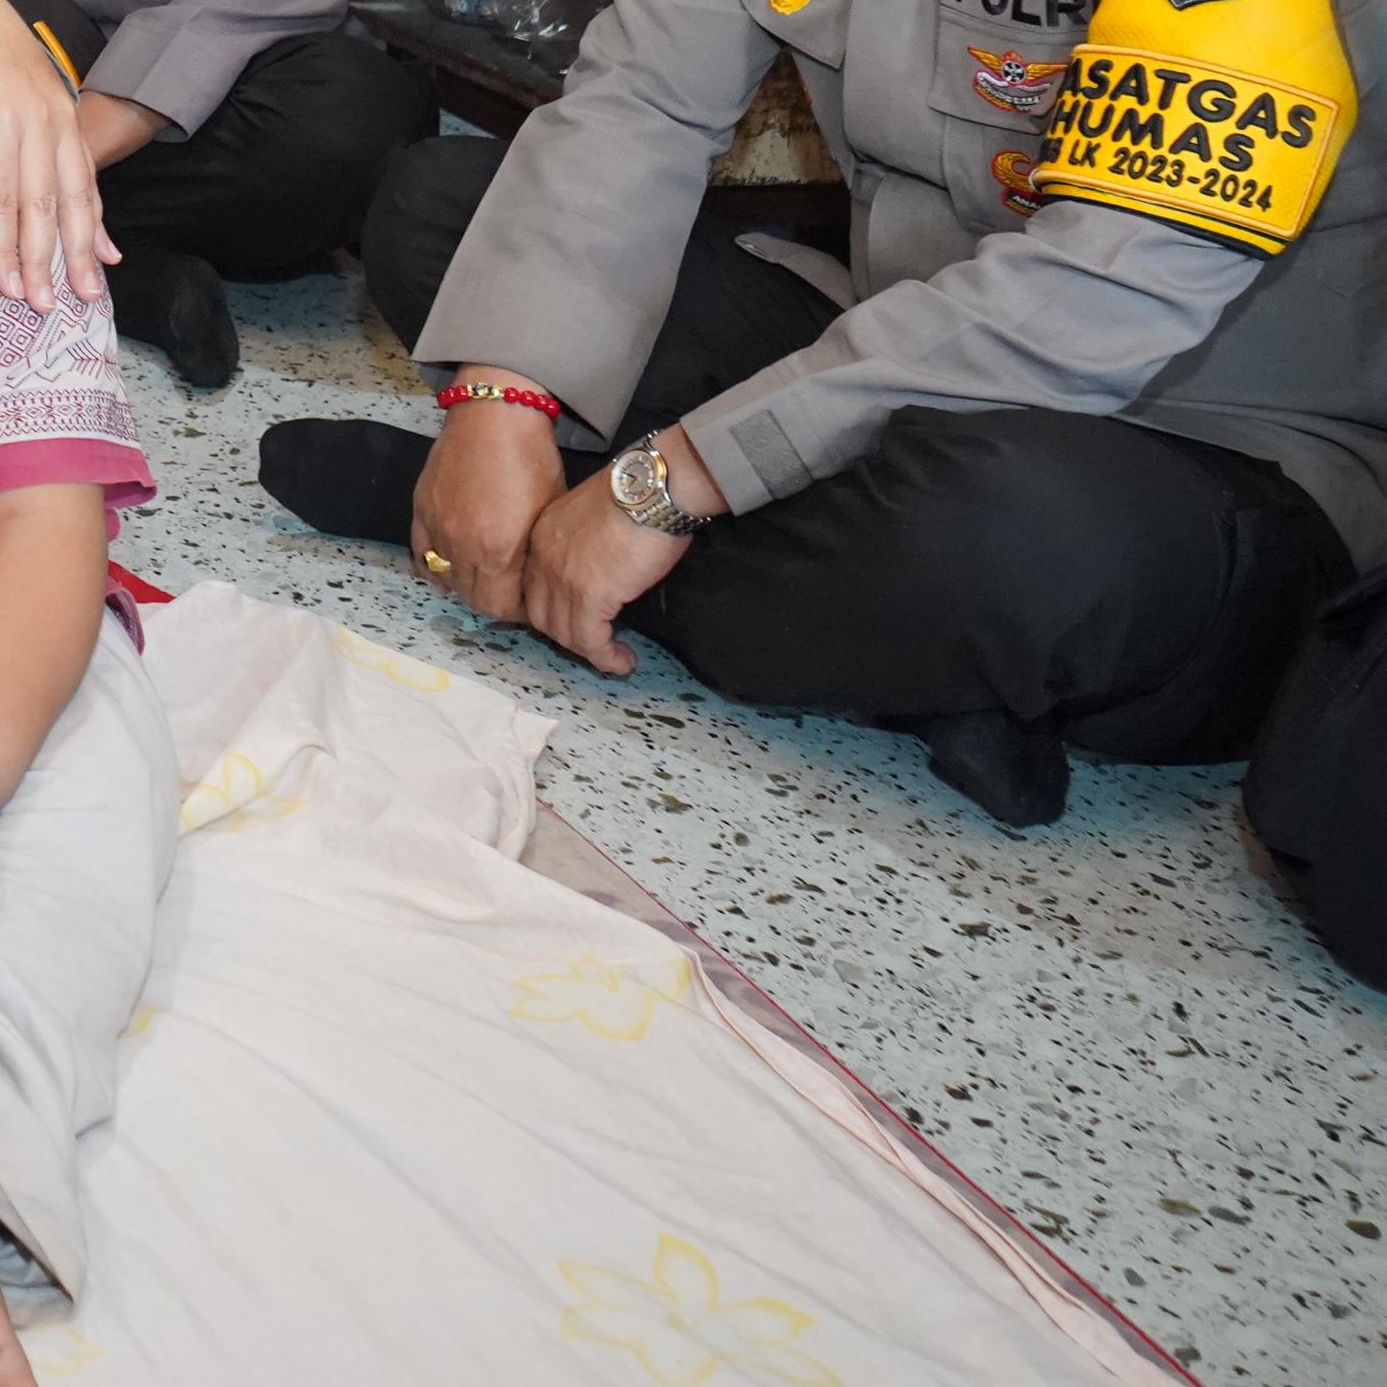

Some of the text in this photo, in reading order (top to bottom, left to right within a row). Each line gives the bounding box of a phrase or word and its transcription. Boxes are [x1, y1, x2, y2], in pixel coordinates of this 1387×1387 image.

[1050, 99, 1256, 173] HUMAS
[1068, 139, 1101, 168] LK
[1108, 146, 1273, 213] 2023-2024
